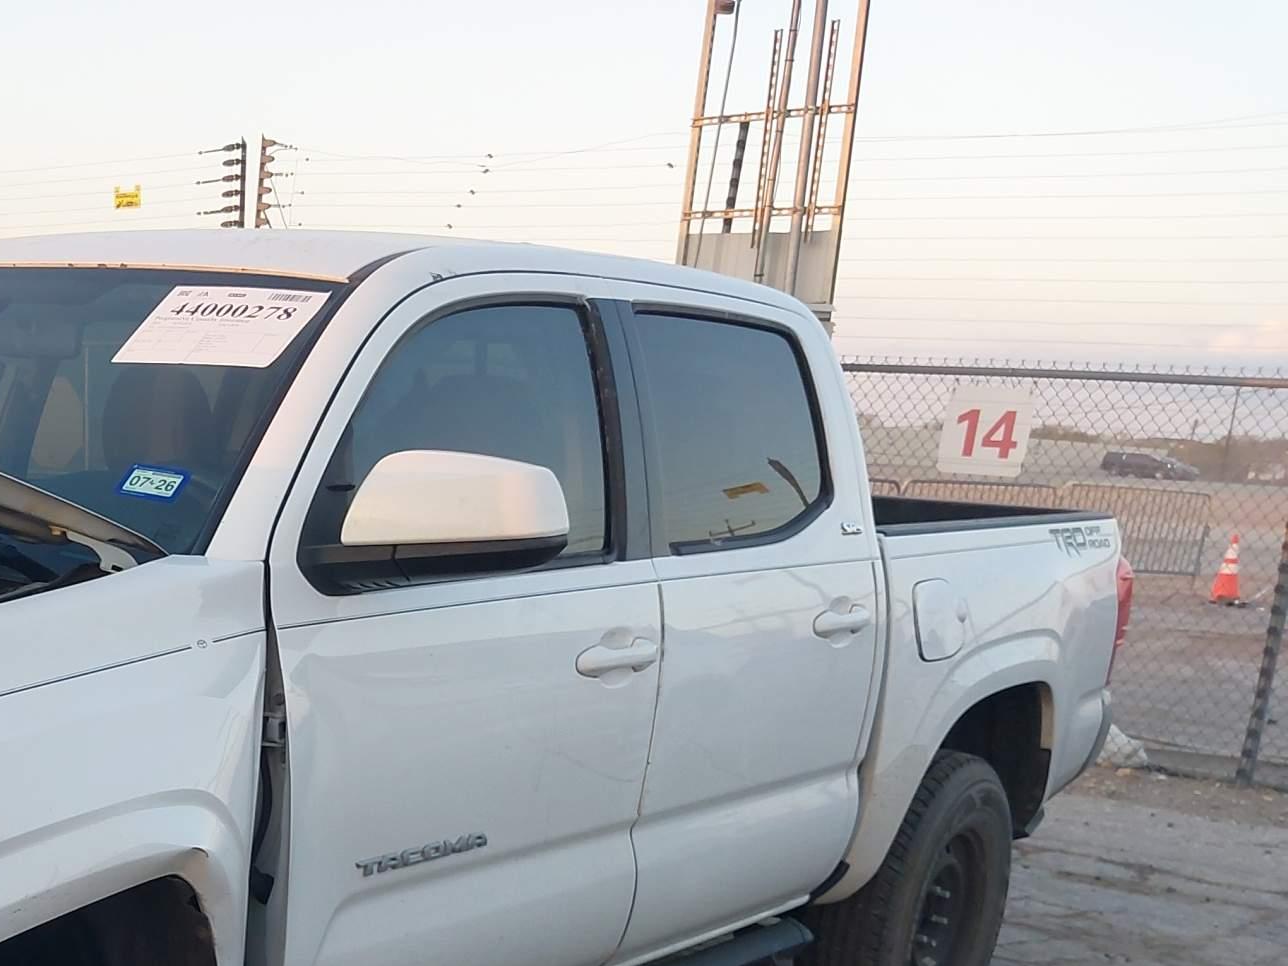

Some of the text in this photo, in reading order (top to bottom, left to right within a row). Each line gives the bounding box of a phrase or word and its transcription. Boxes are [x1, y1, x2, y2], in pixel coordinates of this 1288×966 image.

[170, 302, 297, 321] 44000278
[956, 408, 1018, 459] 14
[1048, 527, 1087, 558] TRD
[355, 831, 488, 877] TACOMA
